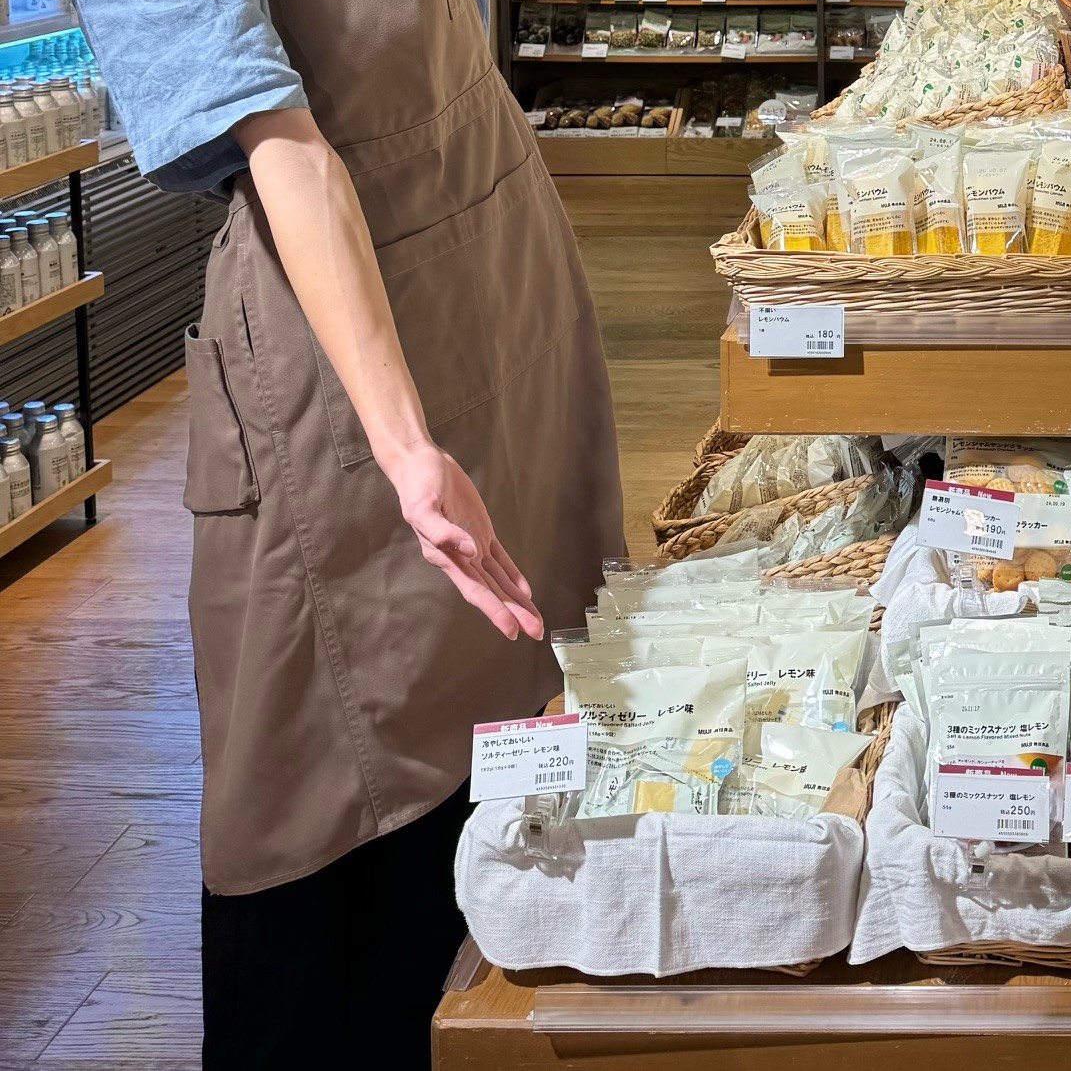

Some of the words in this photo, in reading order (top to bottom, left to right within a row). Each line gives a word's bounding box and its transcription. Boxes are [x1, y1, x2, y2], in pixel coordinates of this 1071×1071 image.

[778, 669, 816, 679] レモン味
[658, 704, 694, 717] レモン味
[947, 725, 1016, 734] 3種のミックスナッツ
[1020, 722, 1049, 732] 塩レモン
[482, 736, 534, 748] 冷やしておいしい
[482, 749, 529, 760] ソルティーゼリー
[534, 745, 560, 754] レモン味
[538, 756, 574, 768] 税込220円
[1001, 806, 1035, 816] 税込250円
